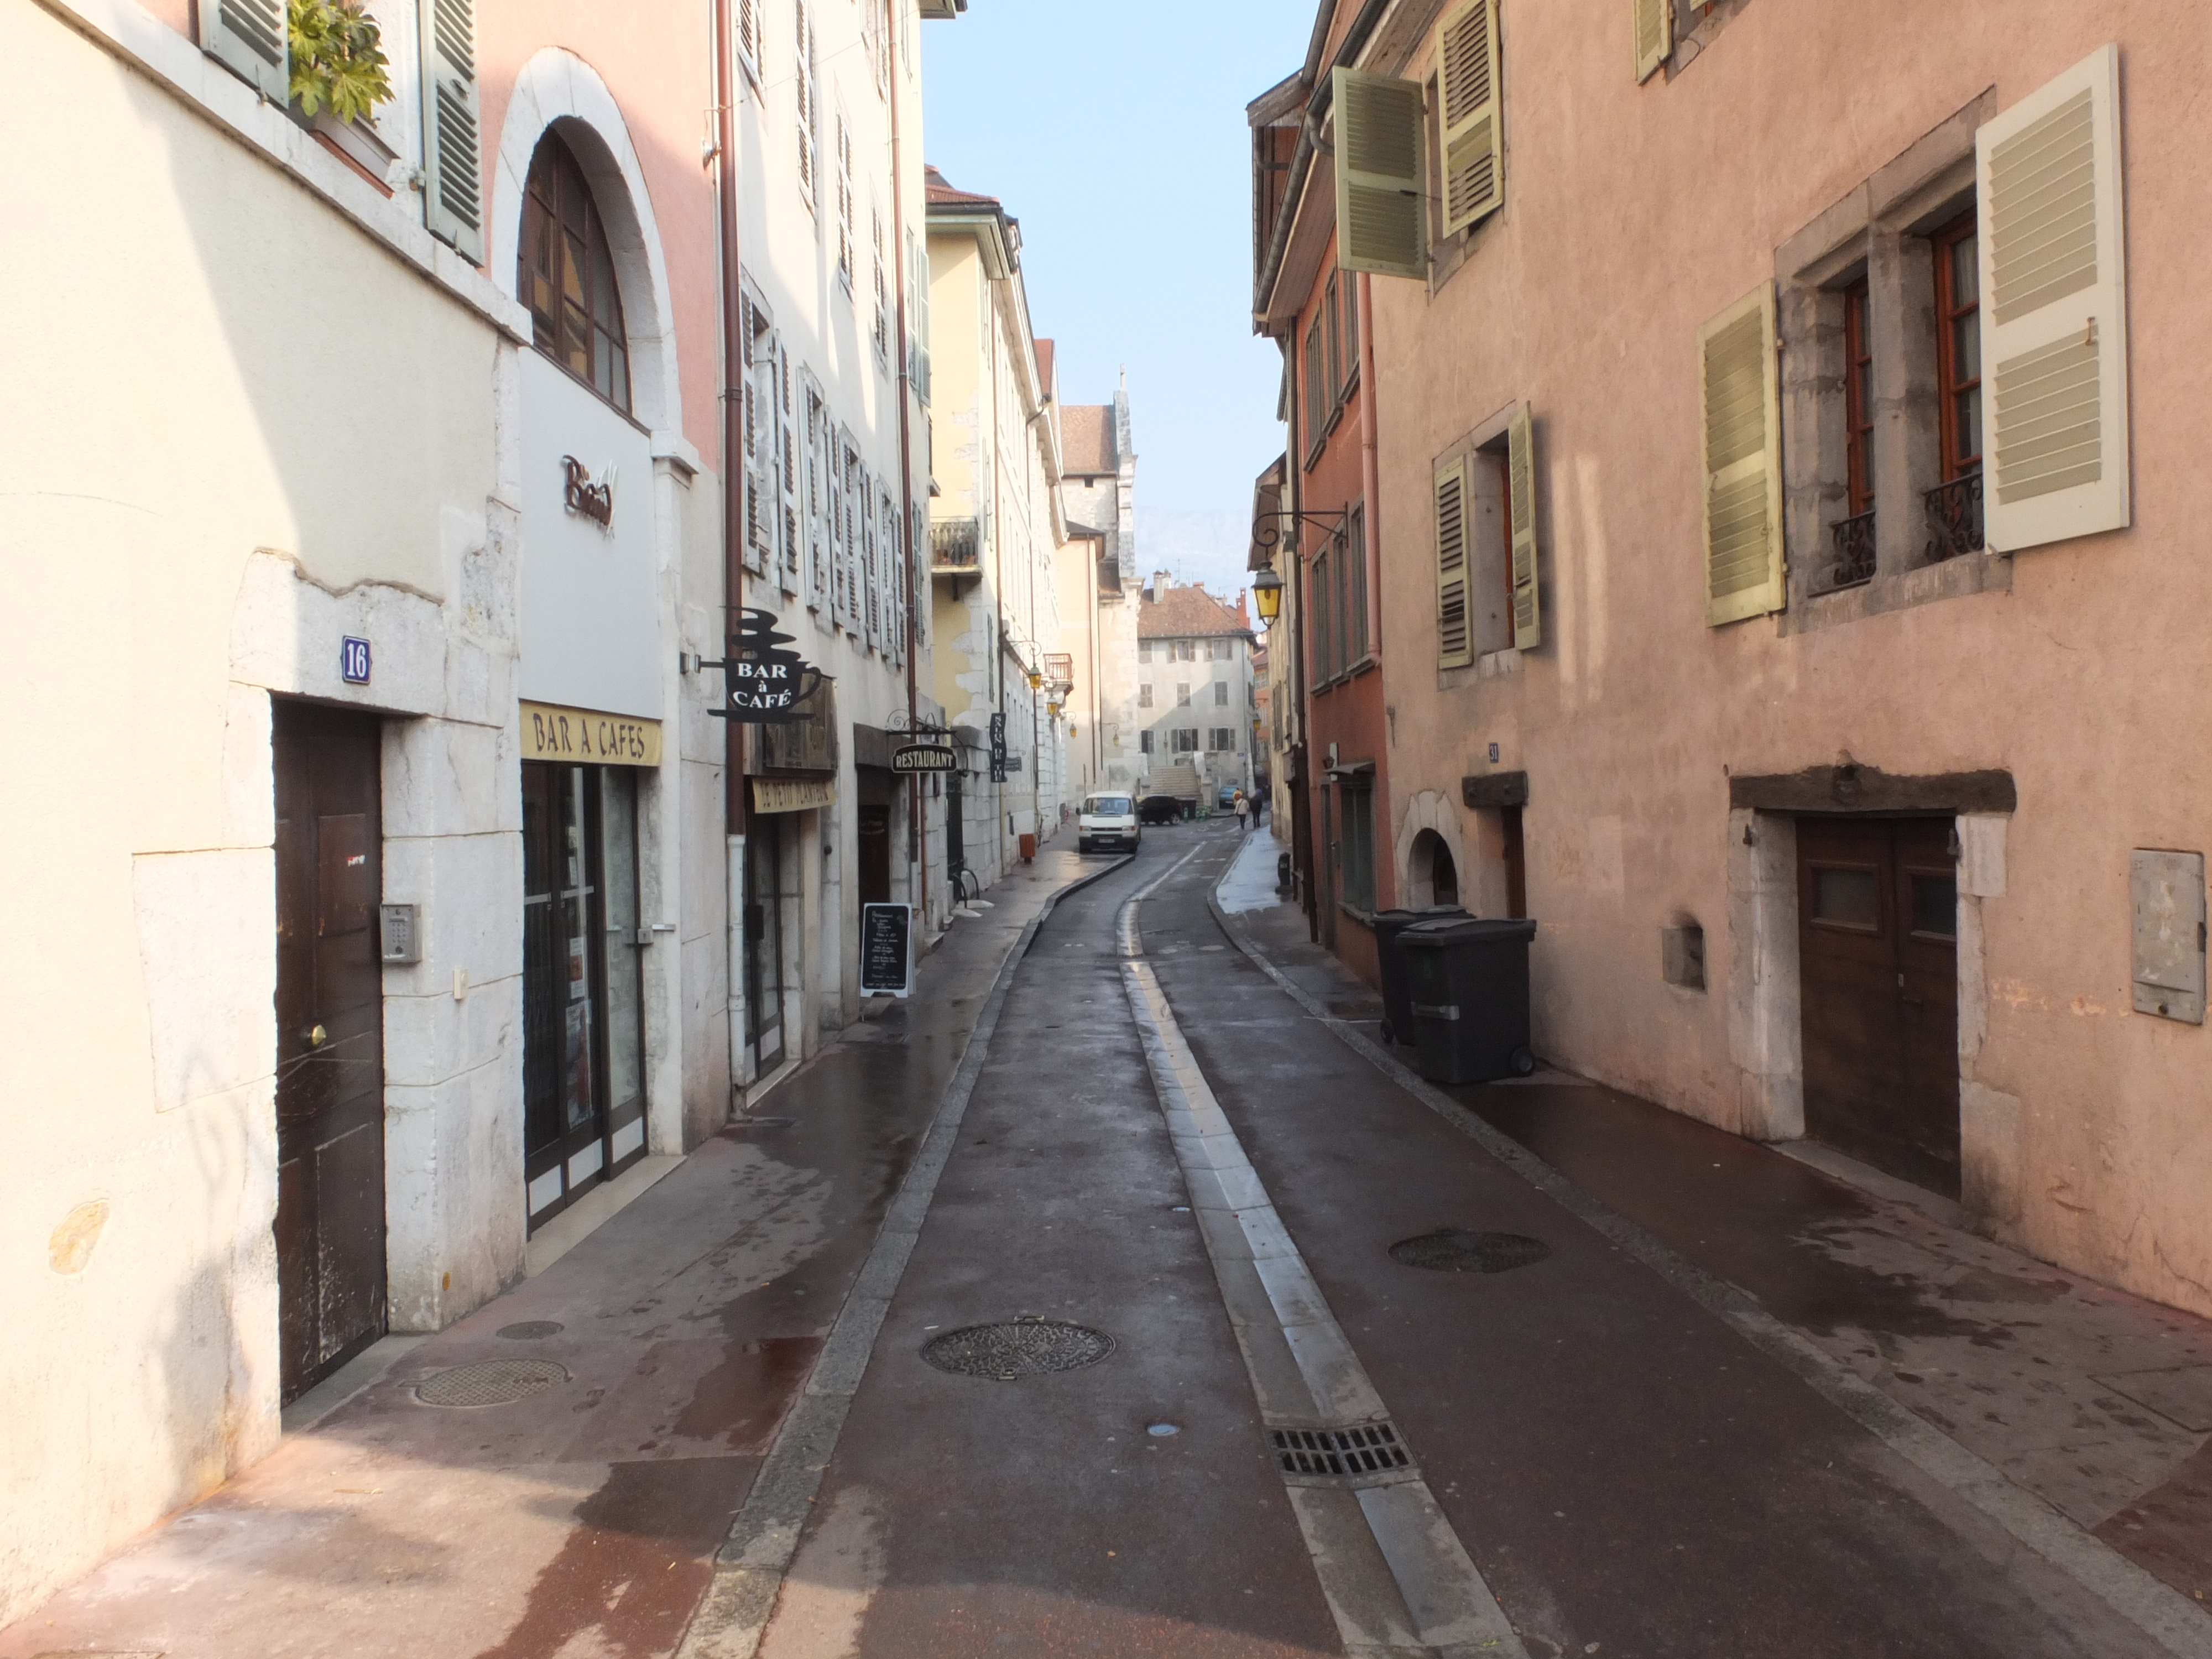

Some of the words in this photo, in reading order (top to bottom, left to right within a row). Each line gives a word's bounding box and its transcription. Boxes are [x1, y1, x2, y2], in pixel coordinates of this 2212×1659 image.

[347, 643, 367, 678] 16
[737, 663, 787, 679] BAR
[758, 680, 768, 693] à
[733, 688, 791, 708] CAFÉ
[533, 713, 572, 753] BAR
[581, 718, 592, 754] A
[599, 721, 645, 759] CAFES
[896, 750, 953, 768] RESTAURANT
[1490, 745, 1497, 760] 31
